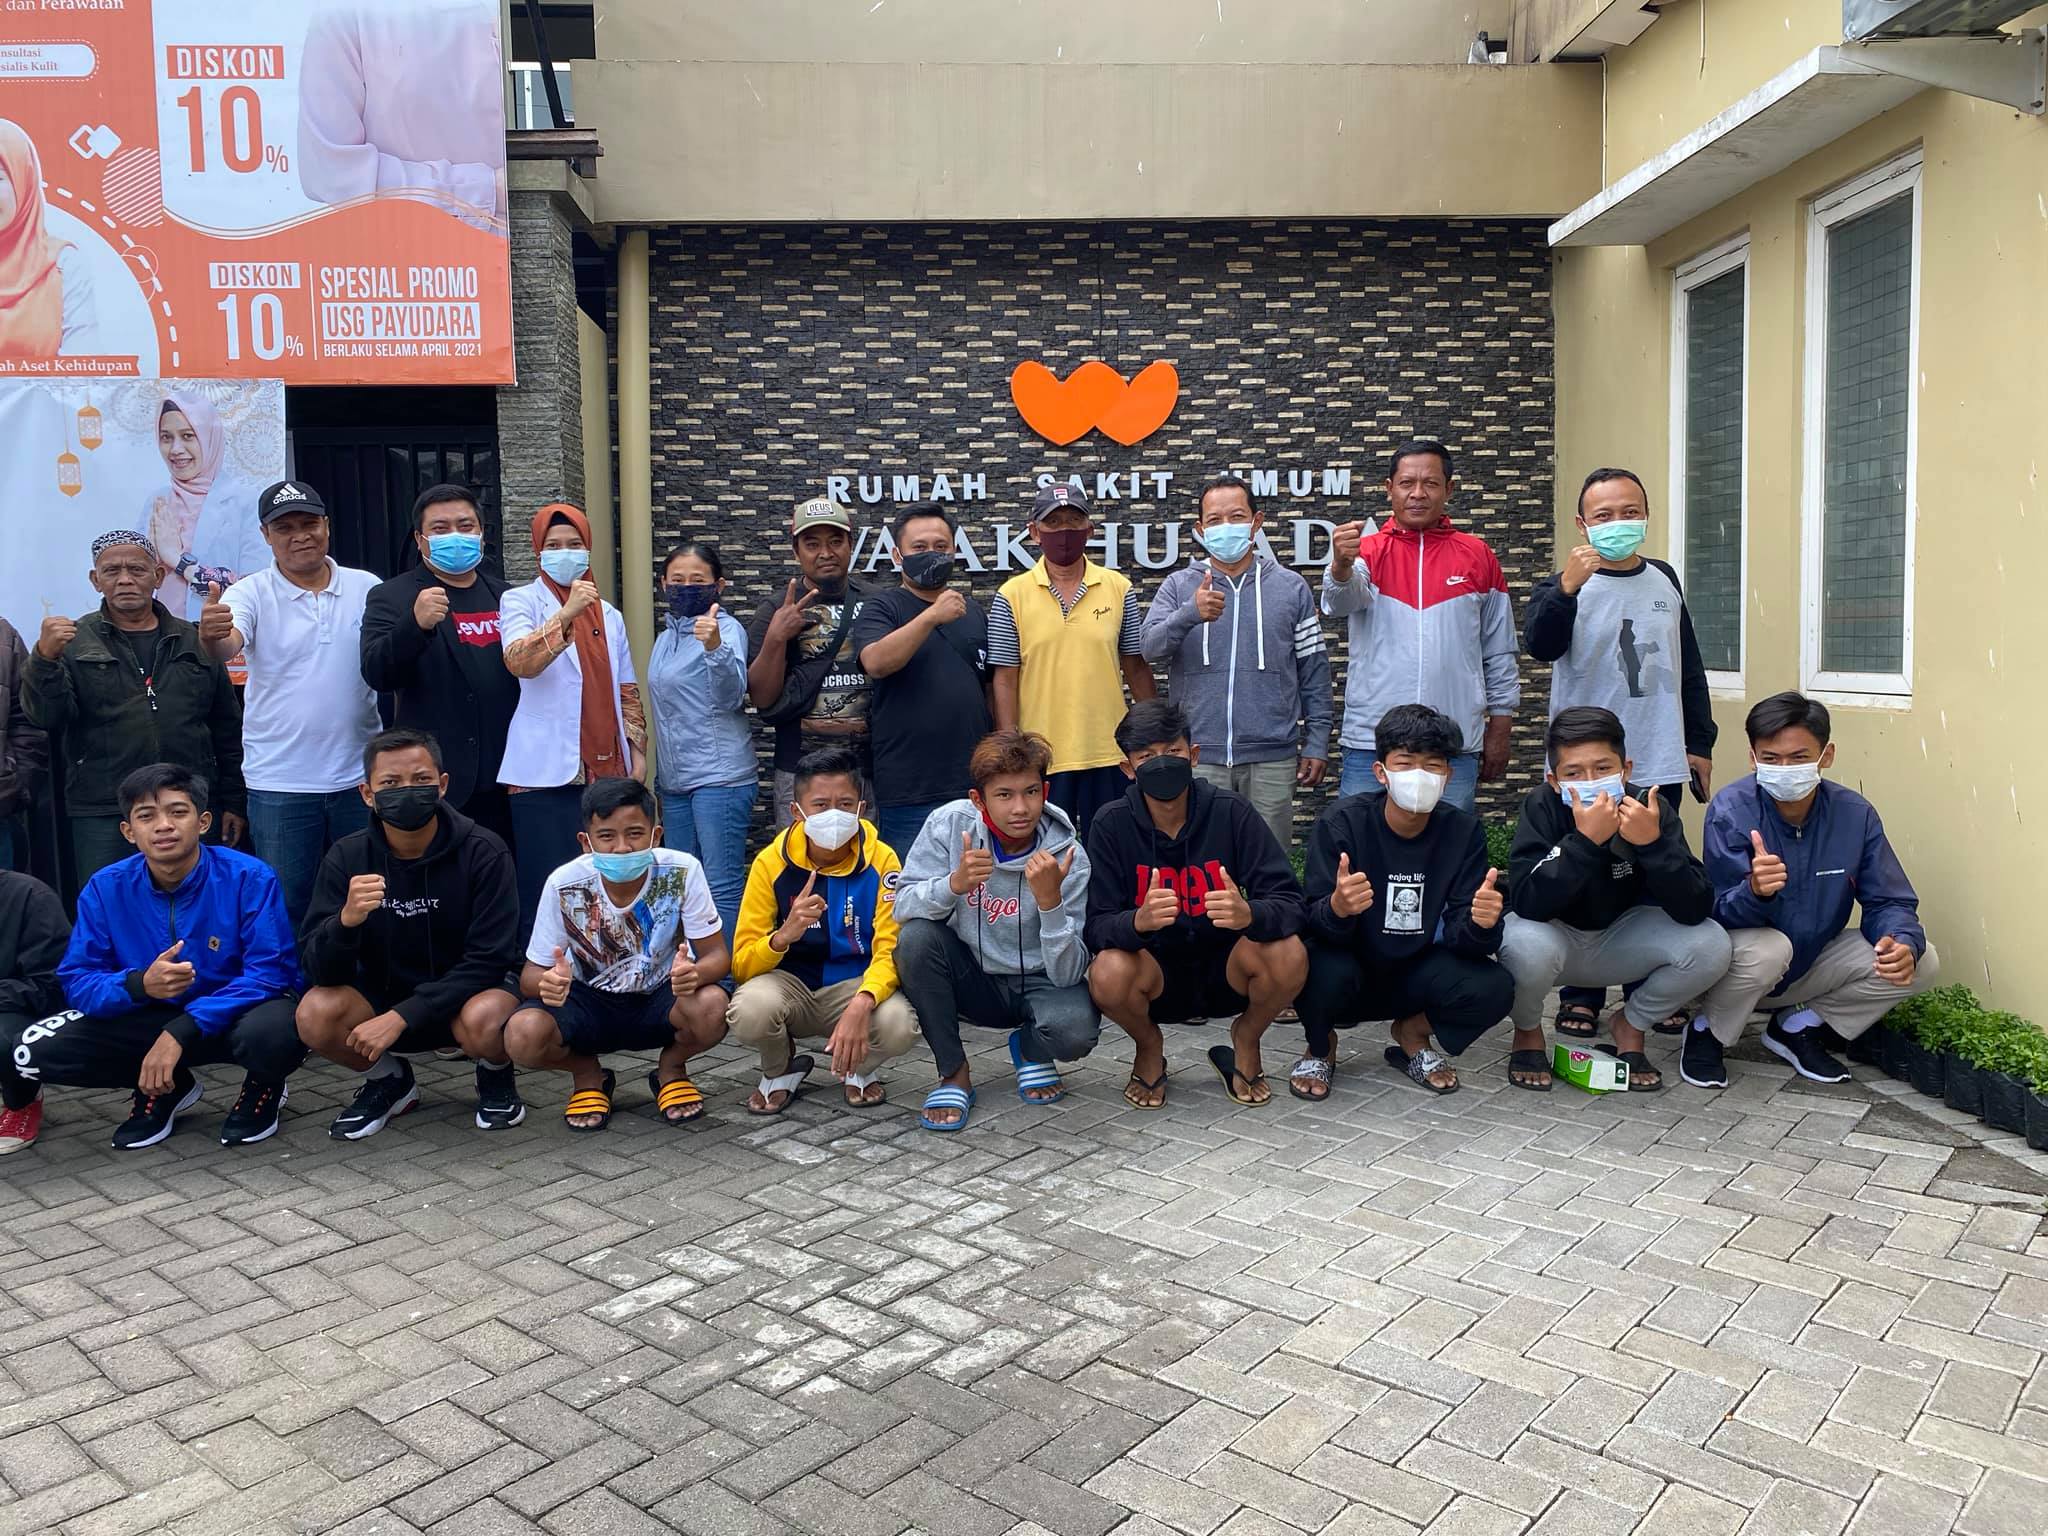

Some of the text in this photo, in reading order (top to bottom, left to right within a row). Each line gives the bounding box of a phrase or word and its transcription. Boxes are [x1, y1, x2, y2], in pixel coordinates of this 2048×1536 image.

[0, 48, 41, 58] nsultasi
[176, 47, 276, 78] DISKON
[0, 61, 58, 72] sialis Kulit
[177, 84, 289, 173] 10%
[217, 264, 294, 287] DISKON
[320, 265, 479, 299] SPESIAL PROMO
[217, 293, 304, 361] 10%
[326, 305, 477, 338] USG PAYUDARA
[323, 342, 482, 357] BERLAKU SELAMA APRIL 2021
[20, 360, 51, 373] Aset
[54, 359, 132, 375] Kehidupan
[827, 472, 987, 504] RUMAH
[1219, 468, 1351, 498] MUM
[809, 503, 831, 512] DEUS
[1388, 873, 1412, 883] enjoy
